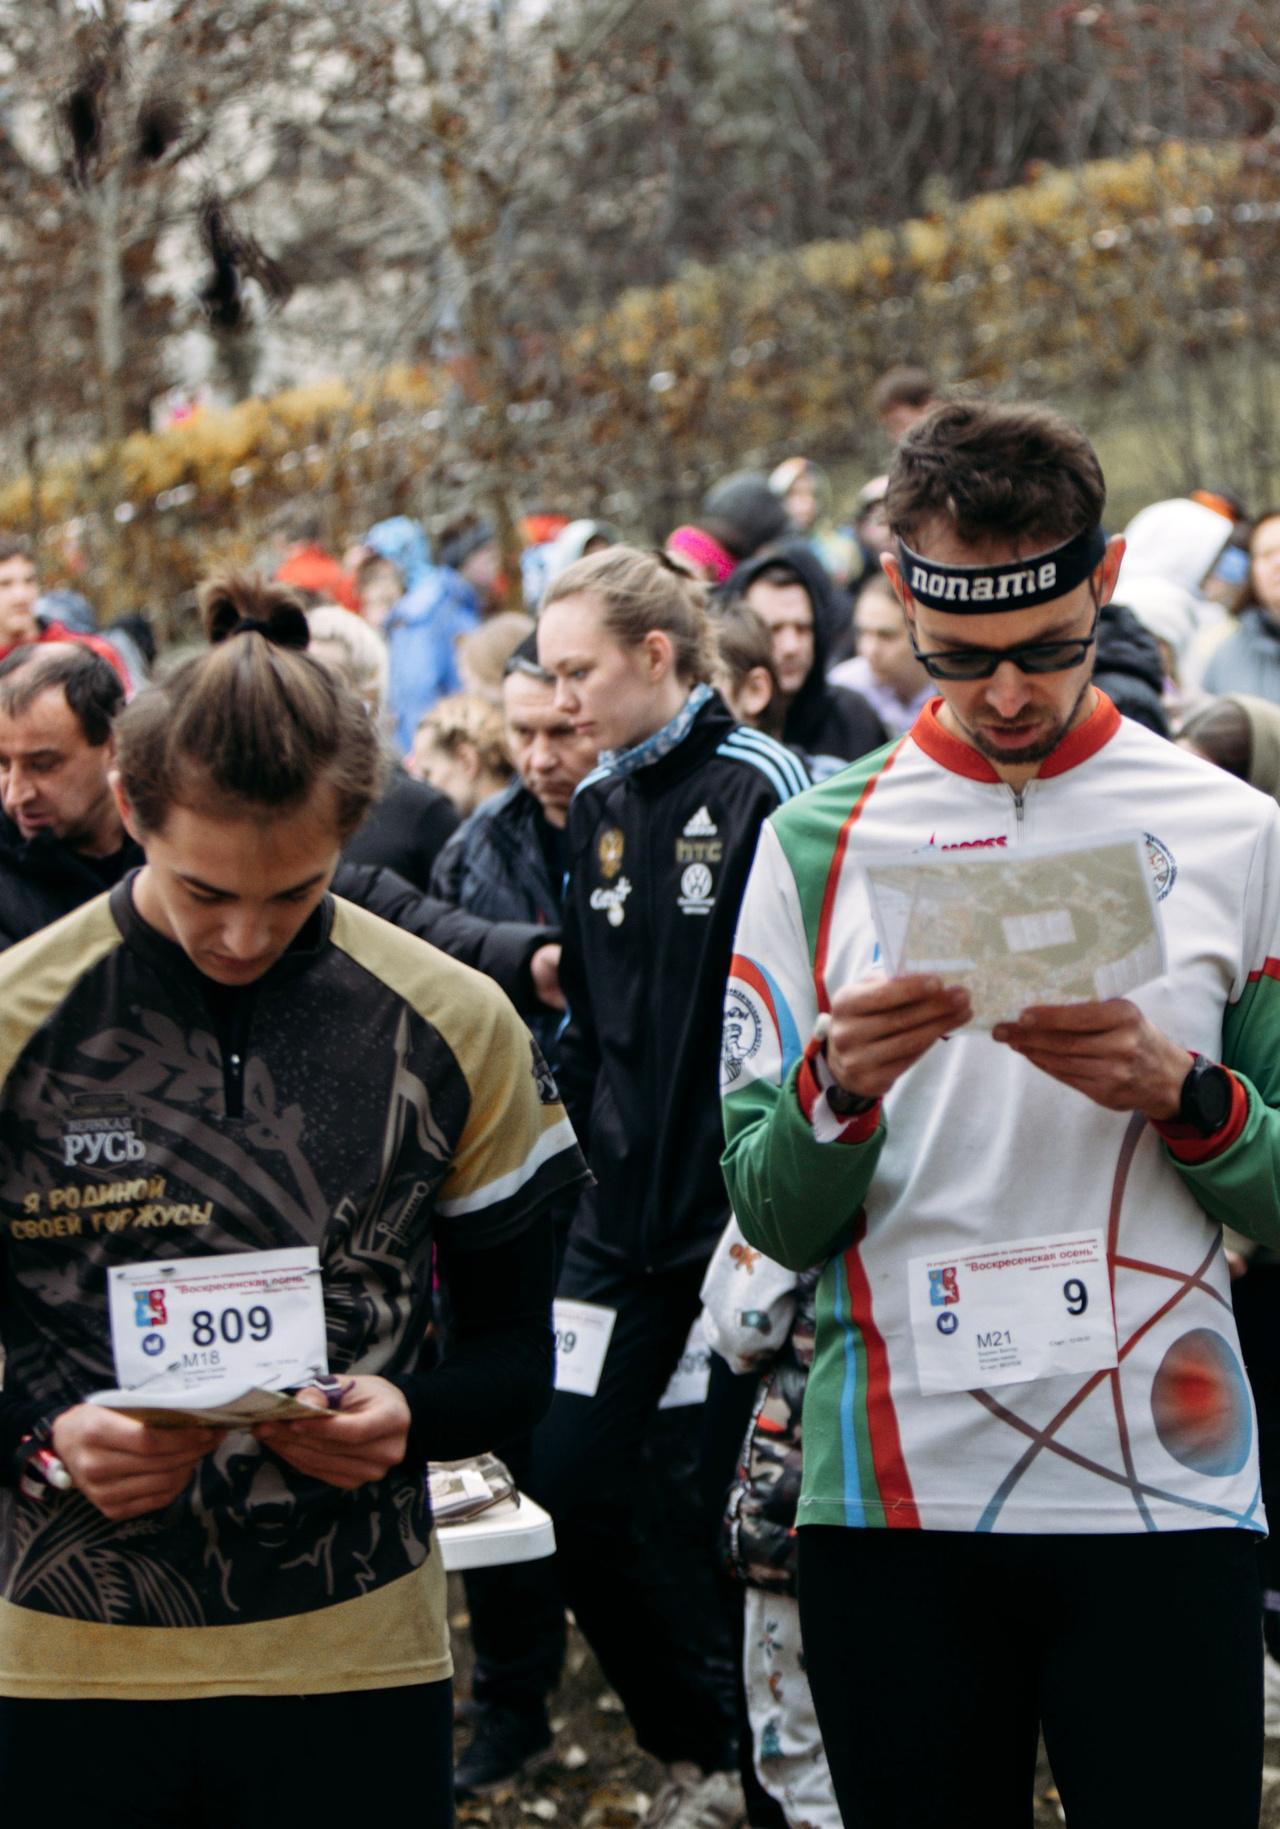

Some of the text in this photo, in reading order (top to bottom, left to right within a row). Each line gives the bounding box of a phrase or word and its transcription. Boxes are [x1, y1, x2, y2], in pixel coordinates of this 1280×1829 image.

[911, 561, 1056, 602] noname
[63, 1130, 147, 1166] РУСЬ
[24, 1174, 167, 1214] Я РОДИНОЙ
[10, 1212, 83, 1239] СВОЕЙ
[965, 1252, 1056, 1271] "Воскресенская
[1063, 1278, 1089, 1316] 9
[192, 1305, 273, 1347] 809
